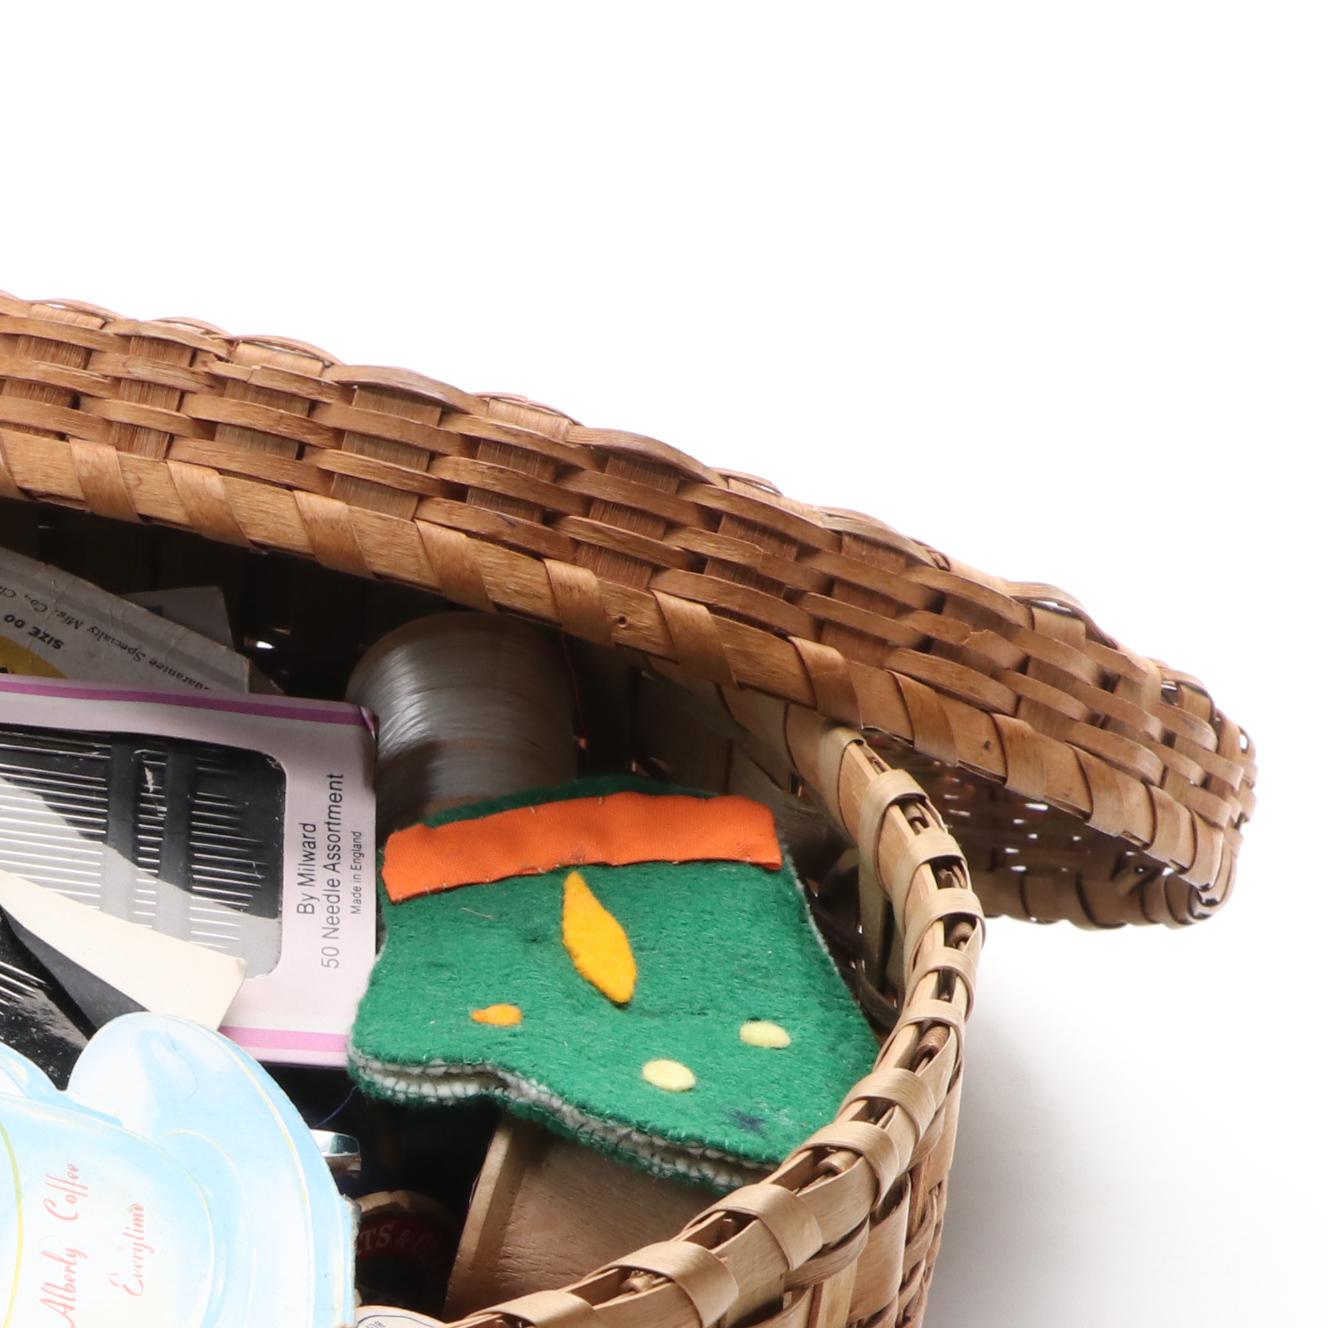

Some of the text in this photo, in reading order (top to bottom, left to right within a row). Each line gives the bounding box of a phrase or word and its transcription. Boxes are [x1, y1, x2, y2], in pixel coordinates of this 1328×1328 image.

[28, 625, 65, 650] SIZE
[54, 608, 84, 630] Mfg.
[86, 624, 146, 663] Specialty
[148, 656, 211, 690] uarantee
[297, 822, 320, 915] By Milward
[321, 773, 344, 969] 50 Needle Assortment
[350, 831, 365, 915] Made in England
[43, 1163, 89, 1221] Coffee
